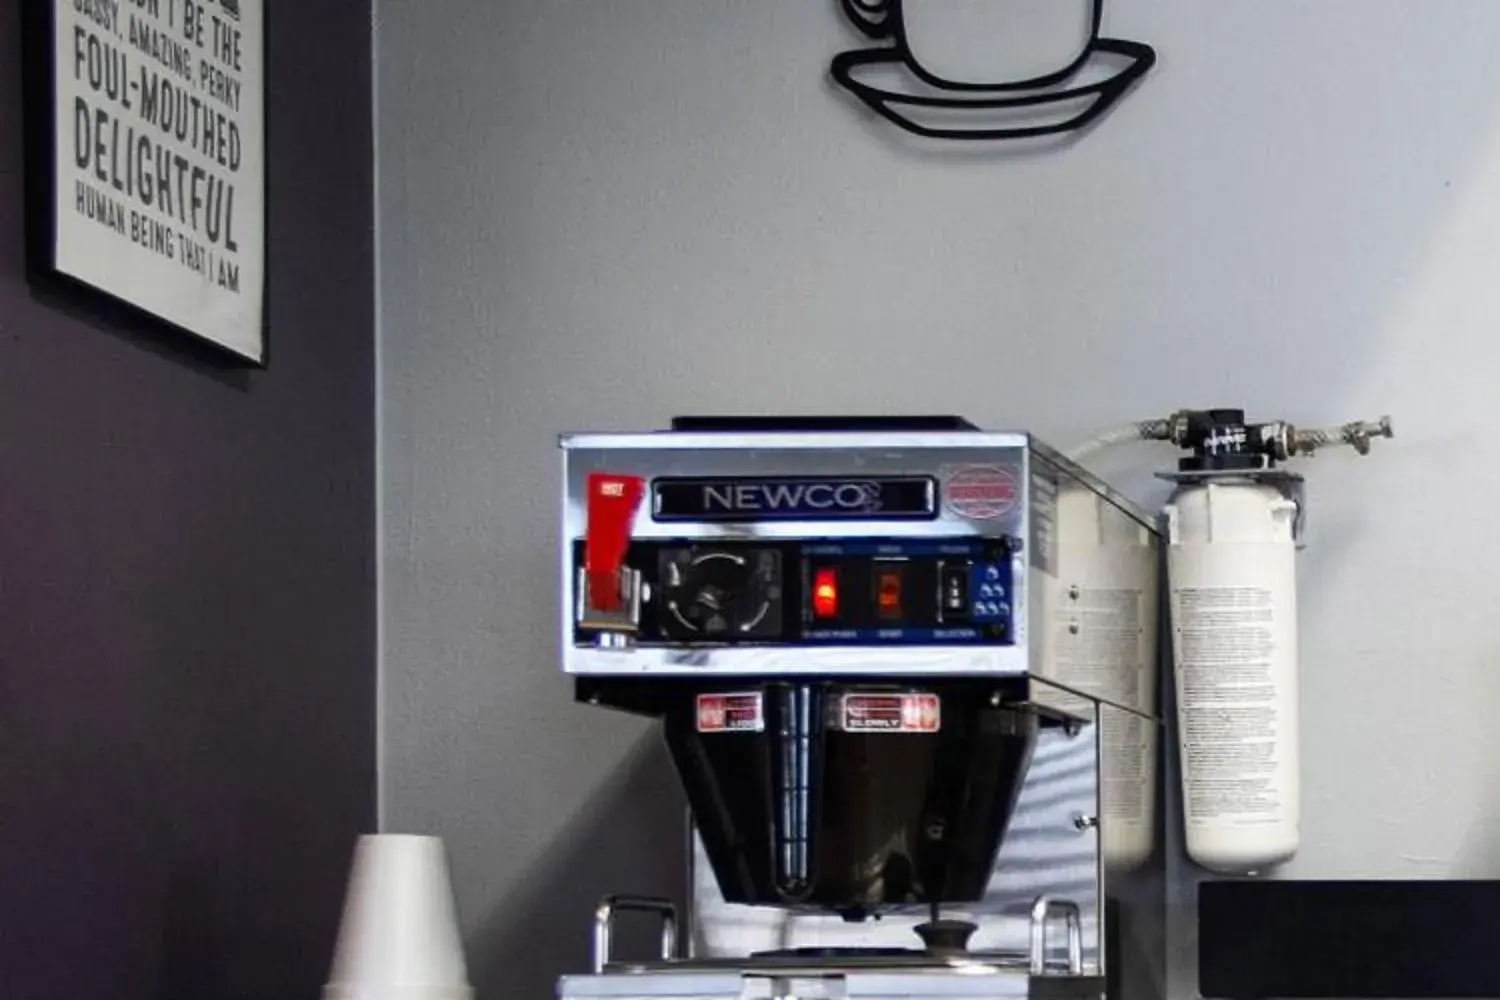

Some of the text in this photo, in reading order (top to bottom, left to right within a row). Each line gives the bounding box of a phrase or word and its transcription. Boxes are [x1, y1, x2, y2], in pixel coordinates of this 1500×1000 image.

[200, 59, 242, 113] PERKY
[212, 15, 242, 72] THE
[74, 25, 241, 172] FOUL-MOUTHED
[75, 95, 239, 253] DELIGHTFUL
[75, 179, 241, 294] HUMAN BEING THAT I AM
[704, 484, 866, 510] NEWCO
